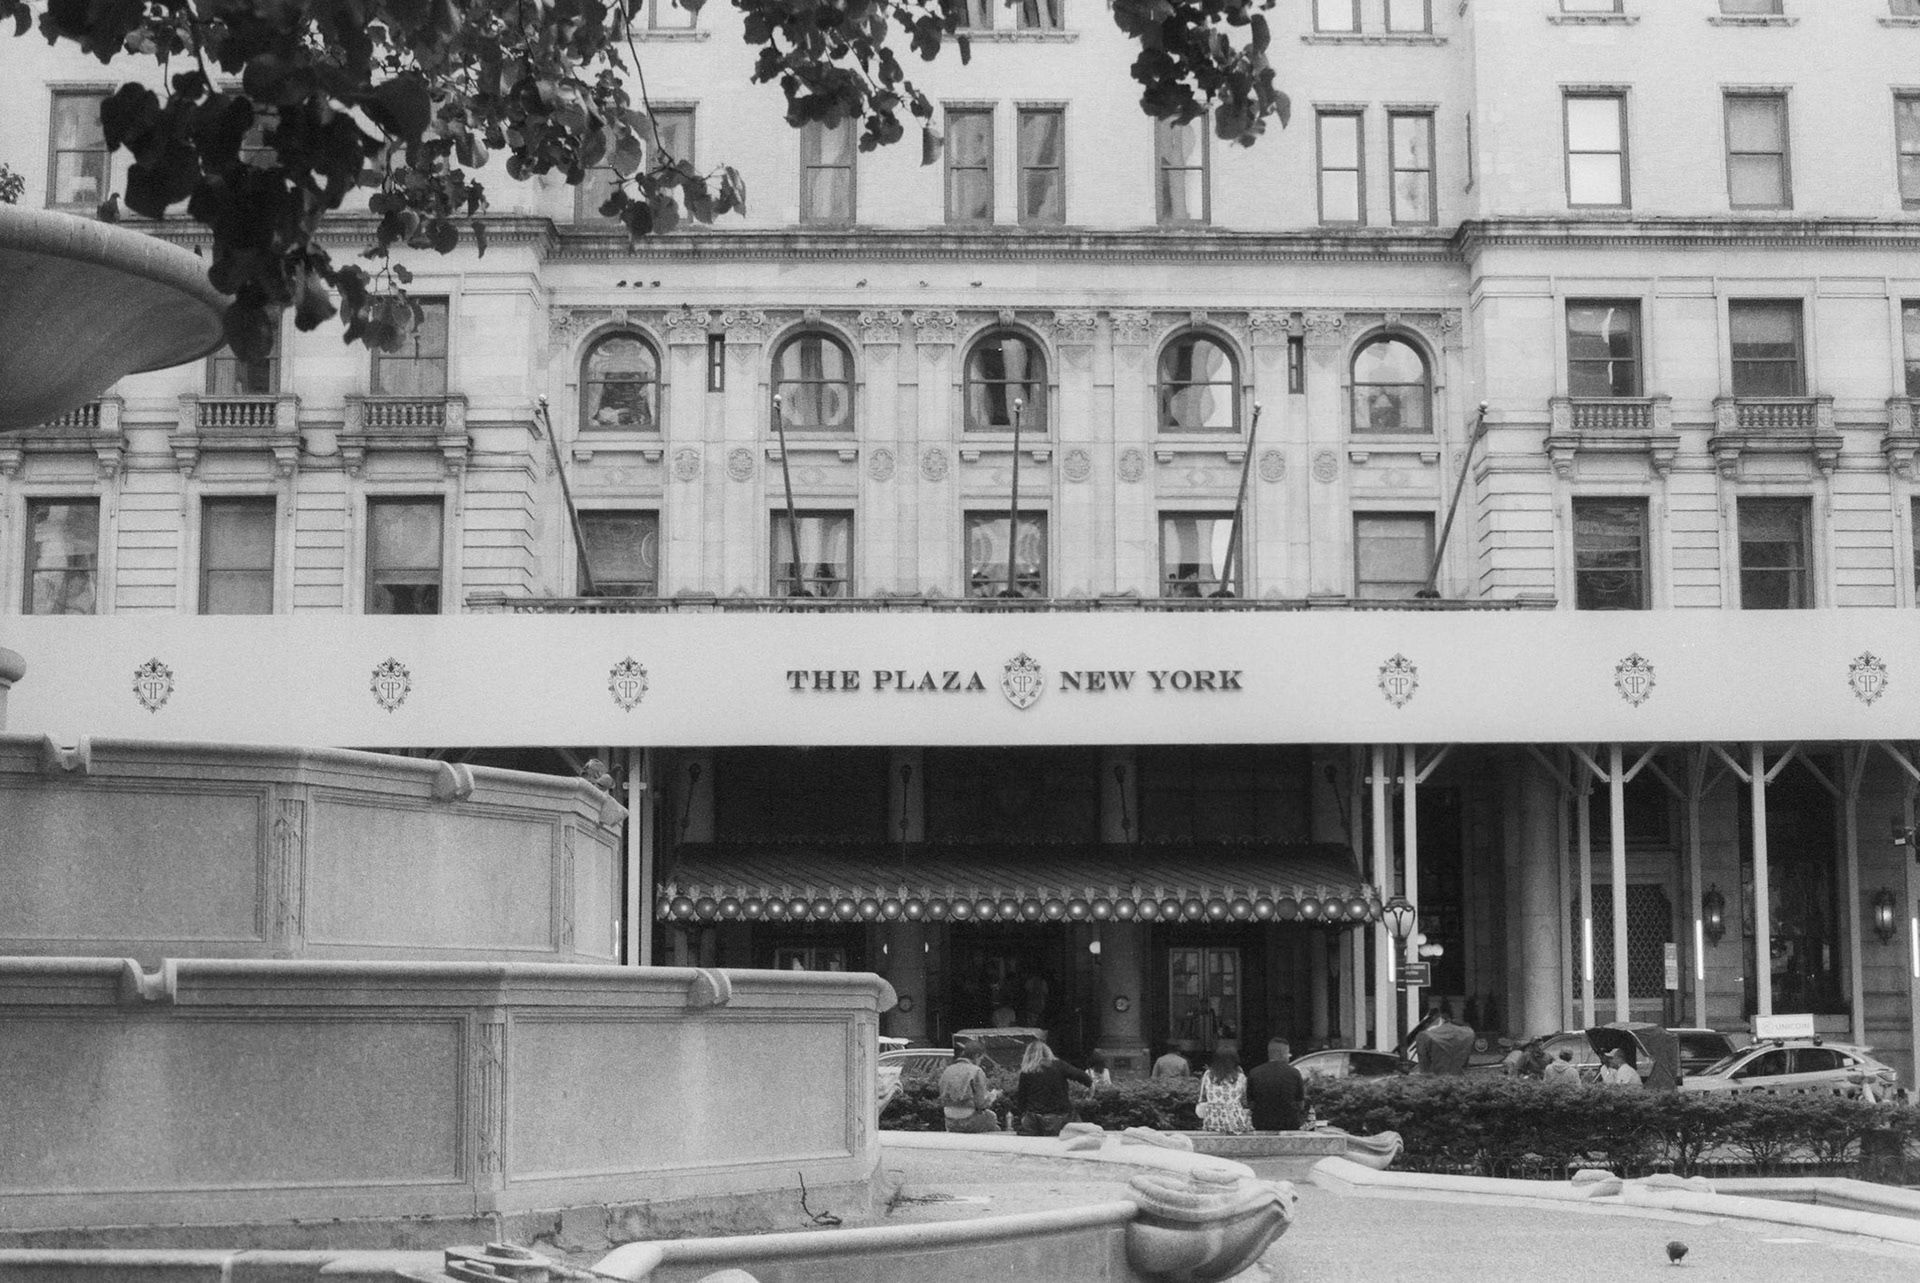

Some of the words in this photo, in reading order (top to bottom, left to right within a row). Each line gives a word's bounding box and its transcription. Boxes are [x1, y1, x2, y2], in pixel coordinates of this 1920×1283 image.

[786, 670, 860, 690] THE
[872, 670, 987, 690] PLAZA
[1059, 670, 1137, 690] NEW
[1147, 670, 1243, 690] YORK
